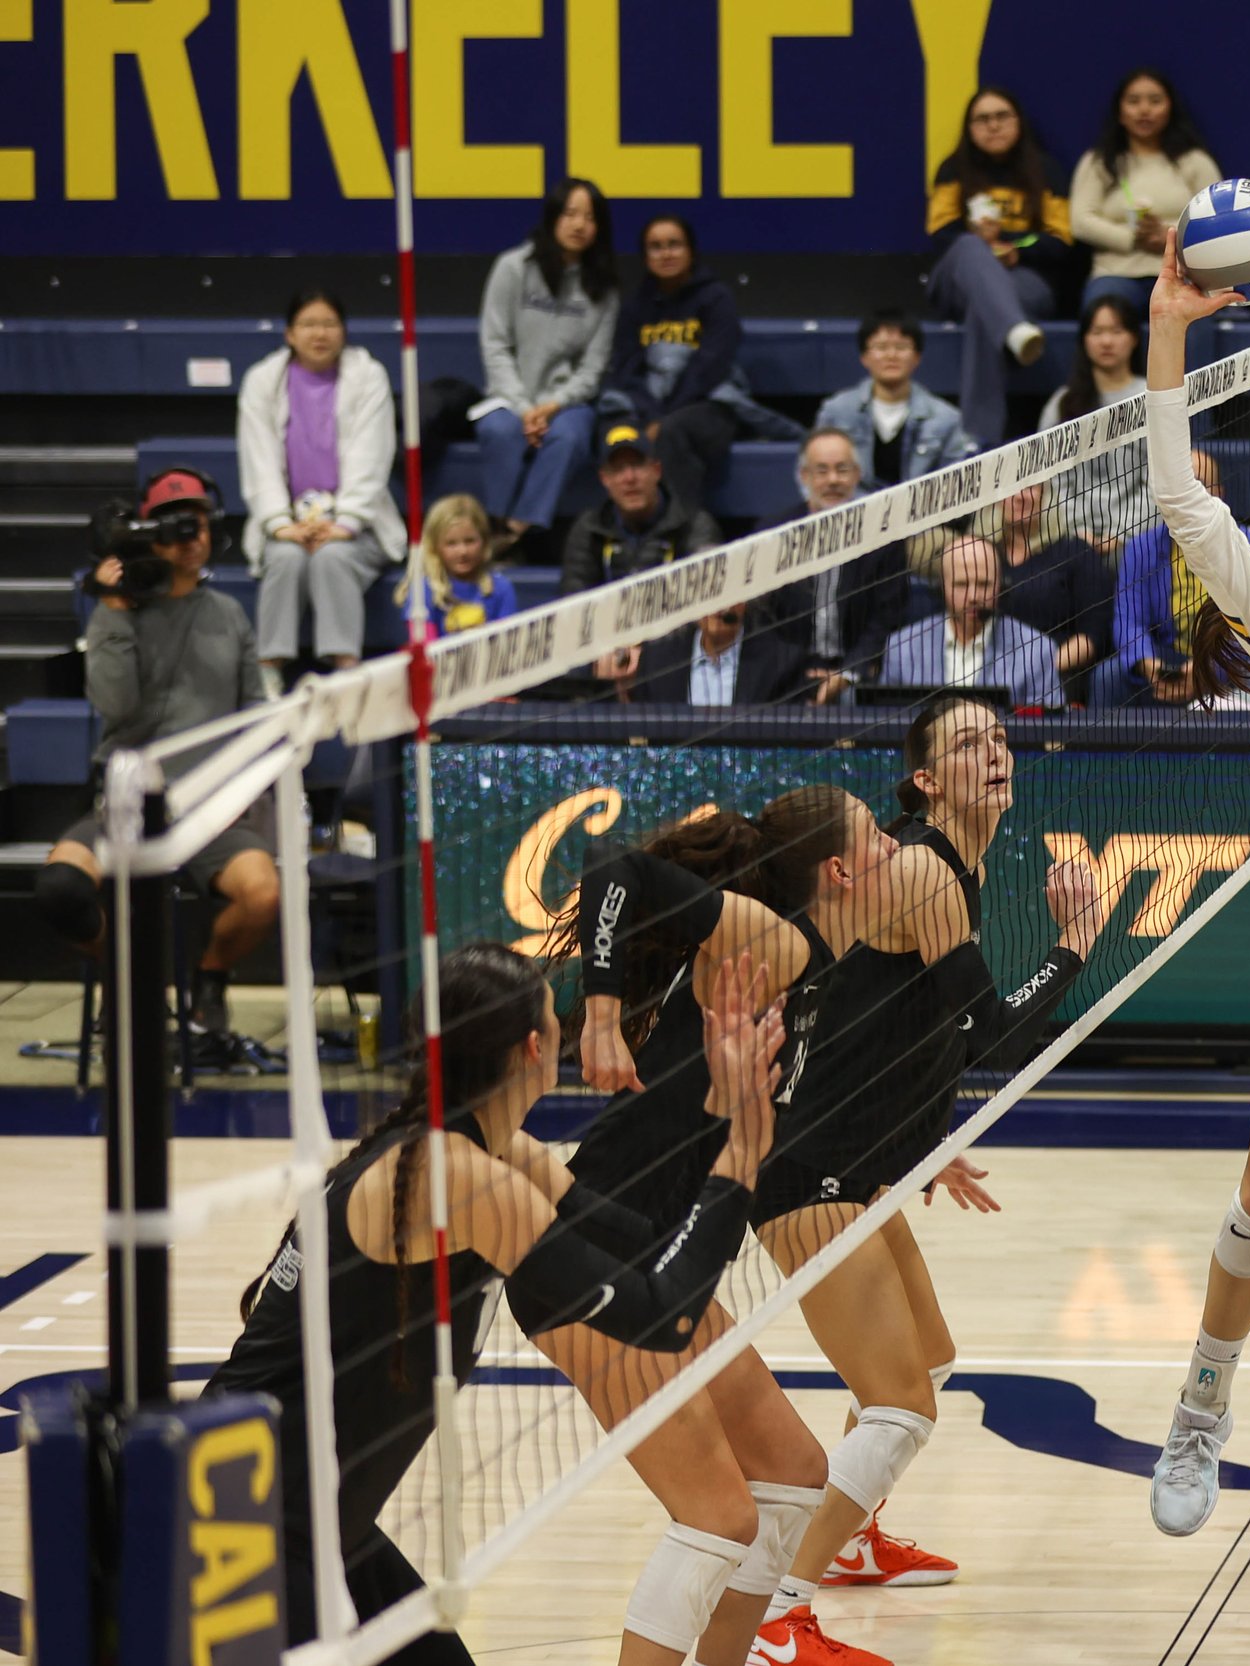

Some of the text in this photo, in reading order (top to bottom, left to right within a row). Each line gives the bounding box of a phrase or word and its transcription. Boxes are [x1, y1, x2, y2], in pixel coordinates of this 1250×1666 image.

[593, 881, 627, 969] HOKIES
[1006, 962, 1058, 1008] HOKIES
[189, 1418, 278, 1666] CAL
